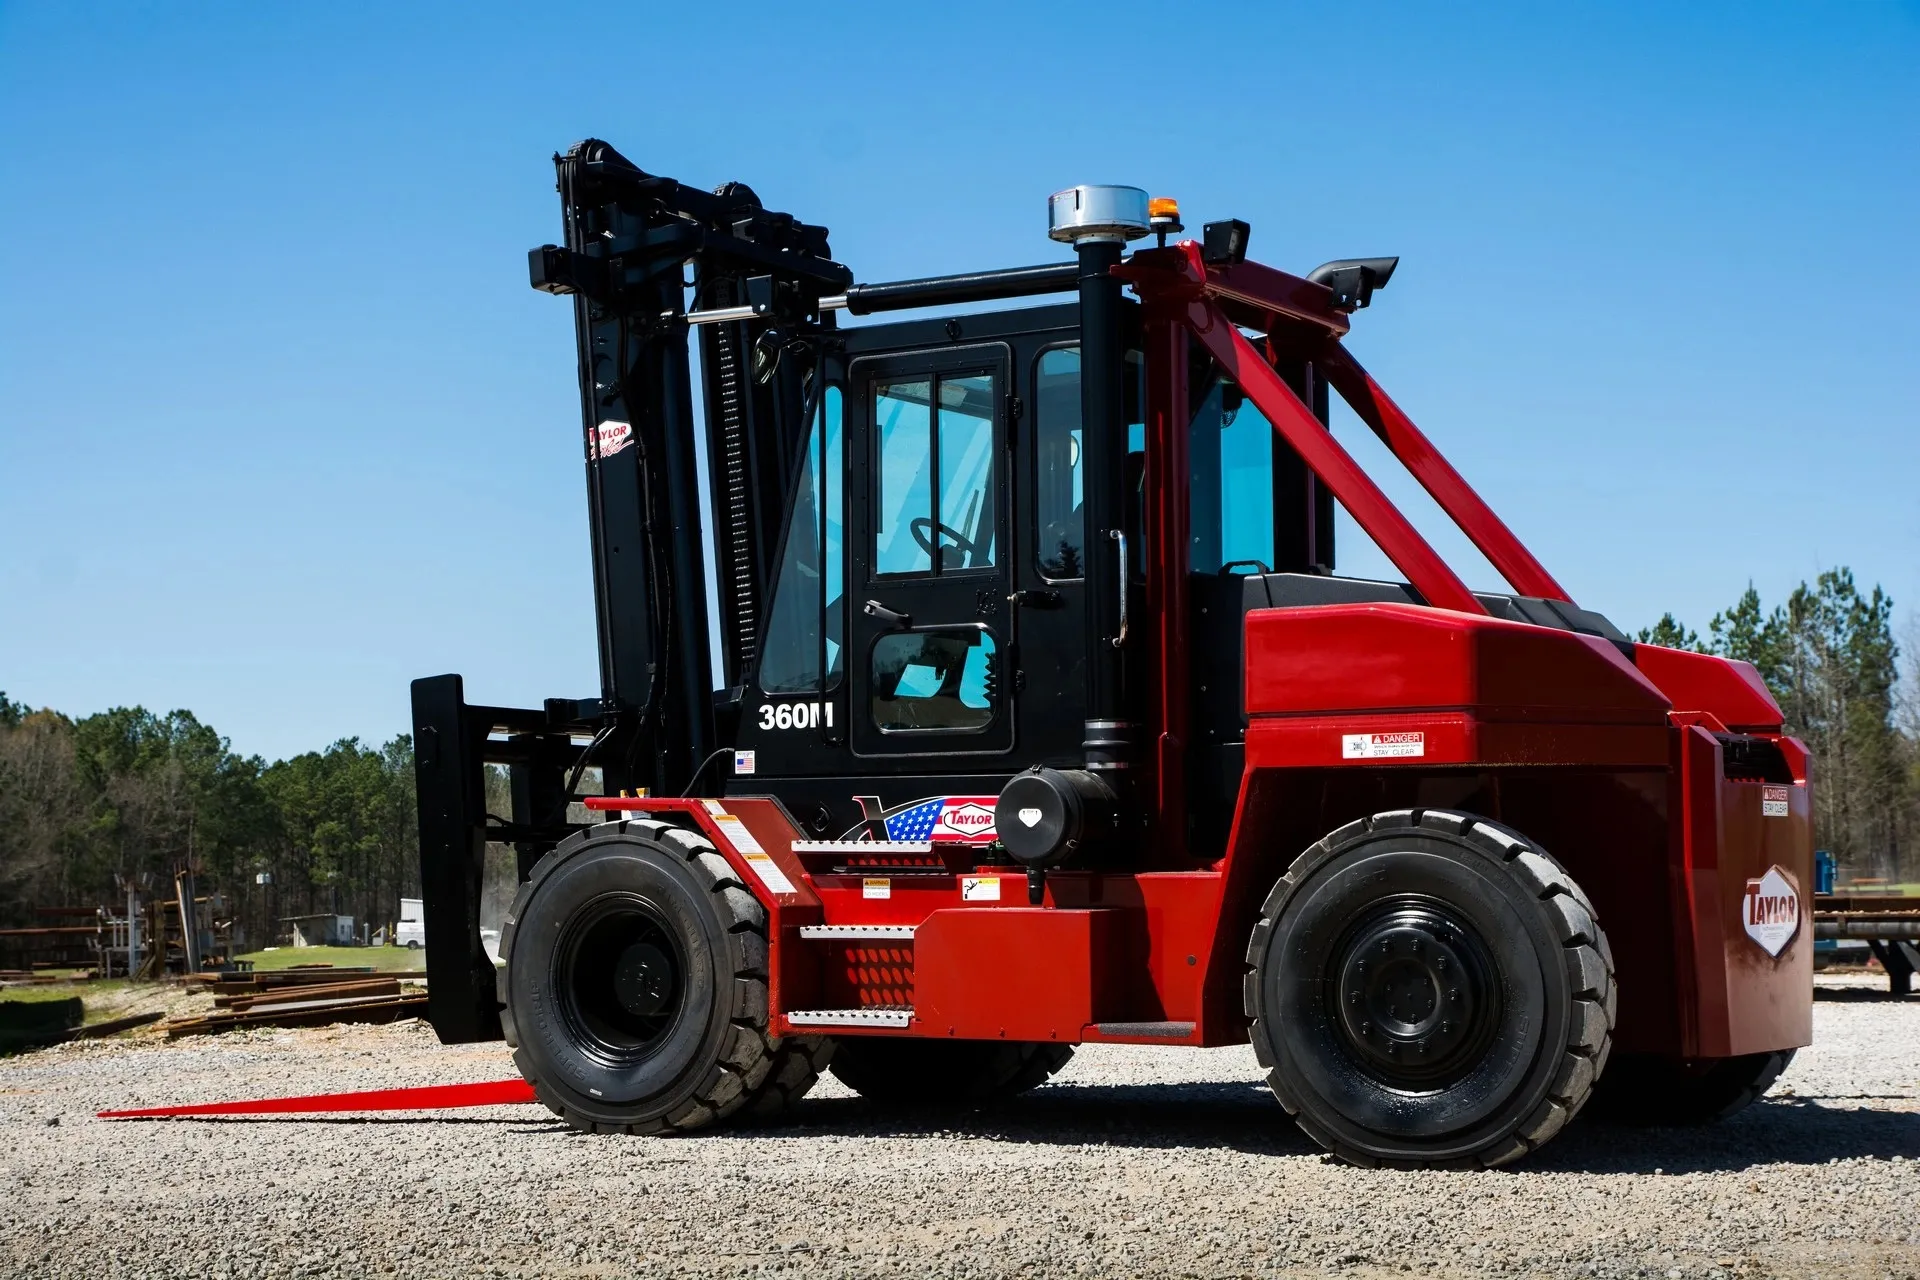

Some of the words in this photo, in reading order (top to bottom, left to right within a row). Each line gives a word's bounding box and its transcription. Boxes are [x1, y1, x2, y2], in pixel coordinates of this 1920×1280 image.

[758, 702, 833, 730] 360M
[1383, 734, 1420, 743] DANGER
[1769, 789, 1787, 800] DANGER
[950, 811, 992, 825] TAYLOR
[1746, 884, 1796, 925] TAYLOR
